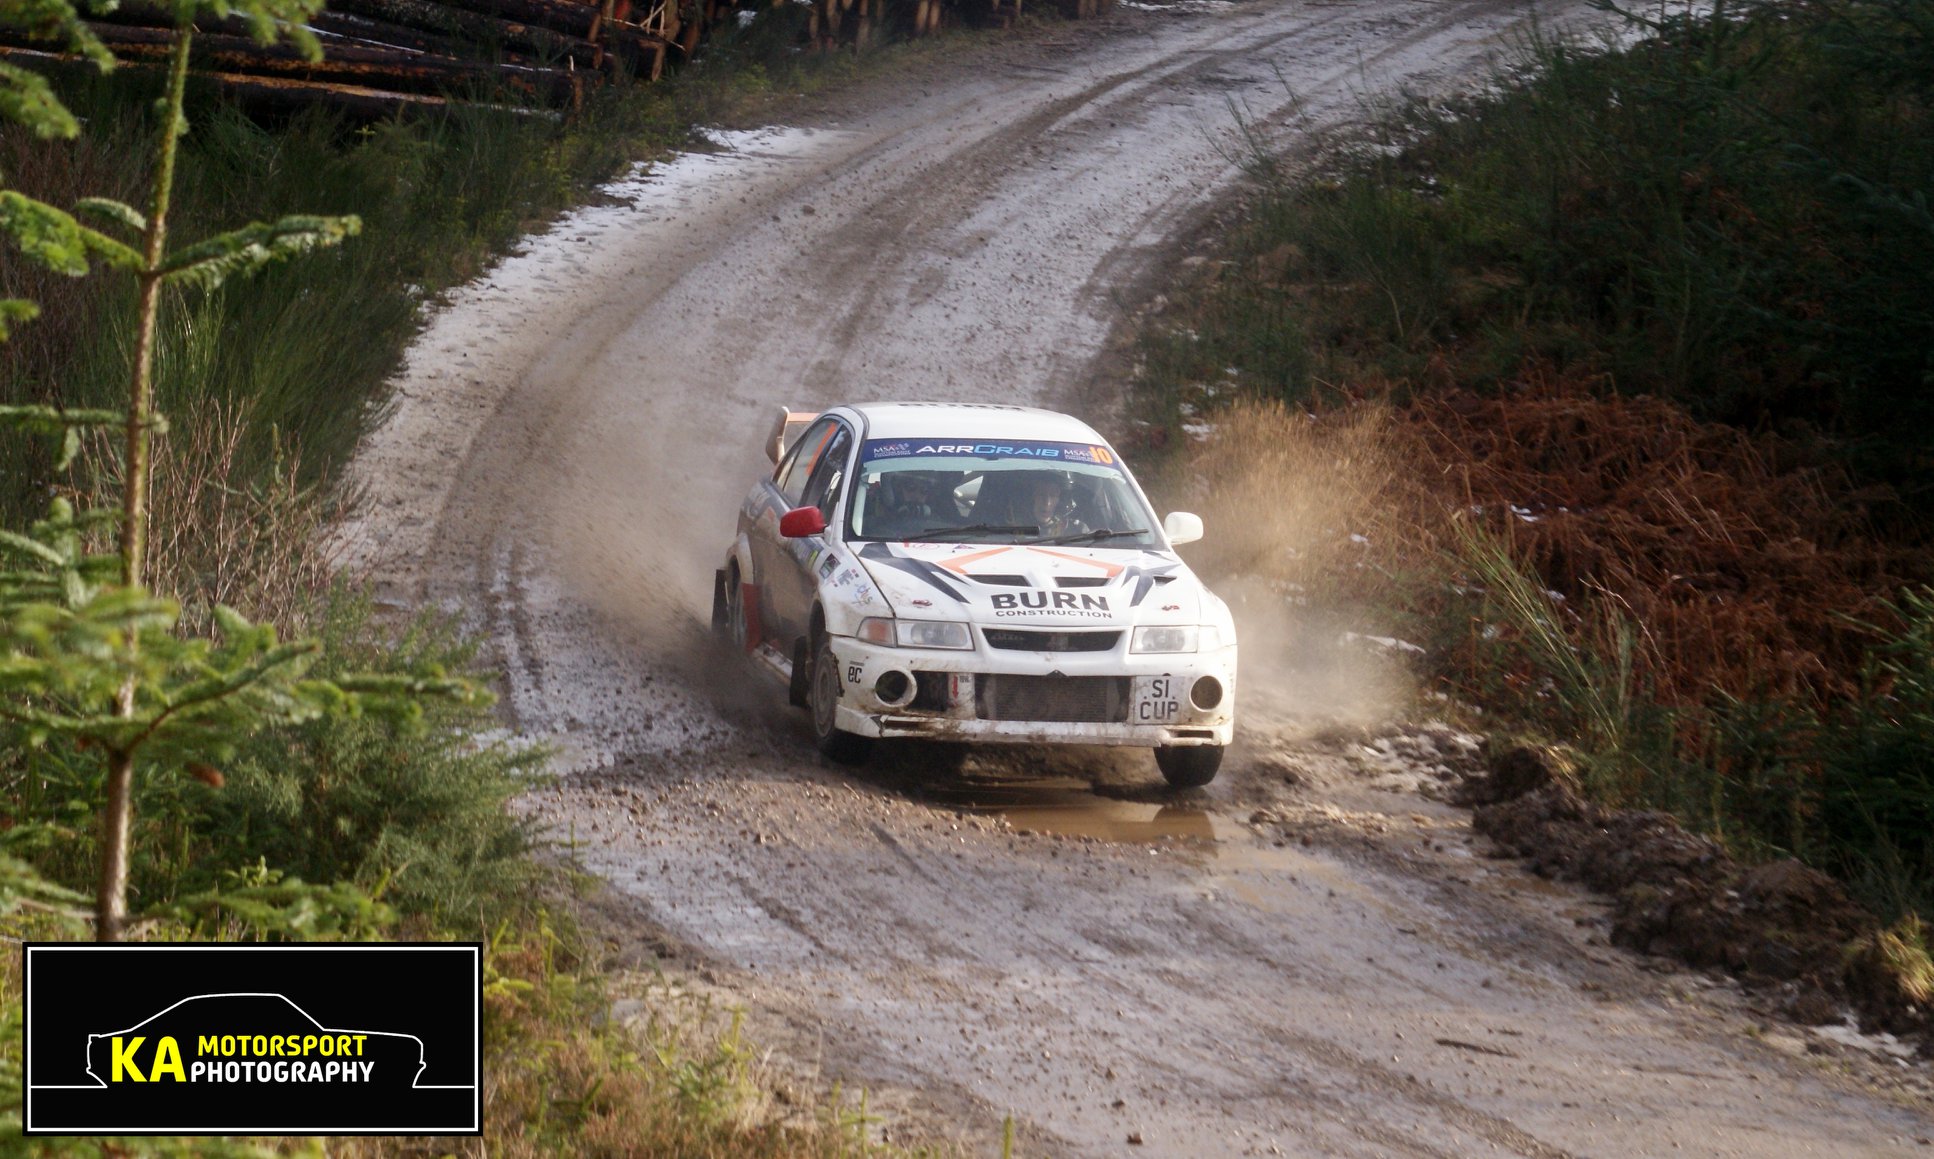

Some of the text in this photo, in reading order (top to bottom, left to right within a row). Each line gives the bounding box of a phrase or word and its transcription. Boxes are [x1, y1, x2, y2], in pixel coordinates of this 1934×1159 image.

[1089, 446, 1113, 465] 10
[990, 591, 1110, 611] BURN
[995, 609, 1113, 619] CONSTRUCTION
[1140, 701, 1179, 720] CUP
